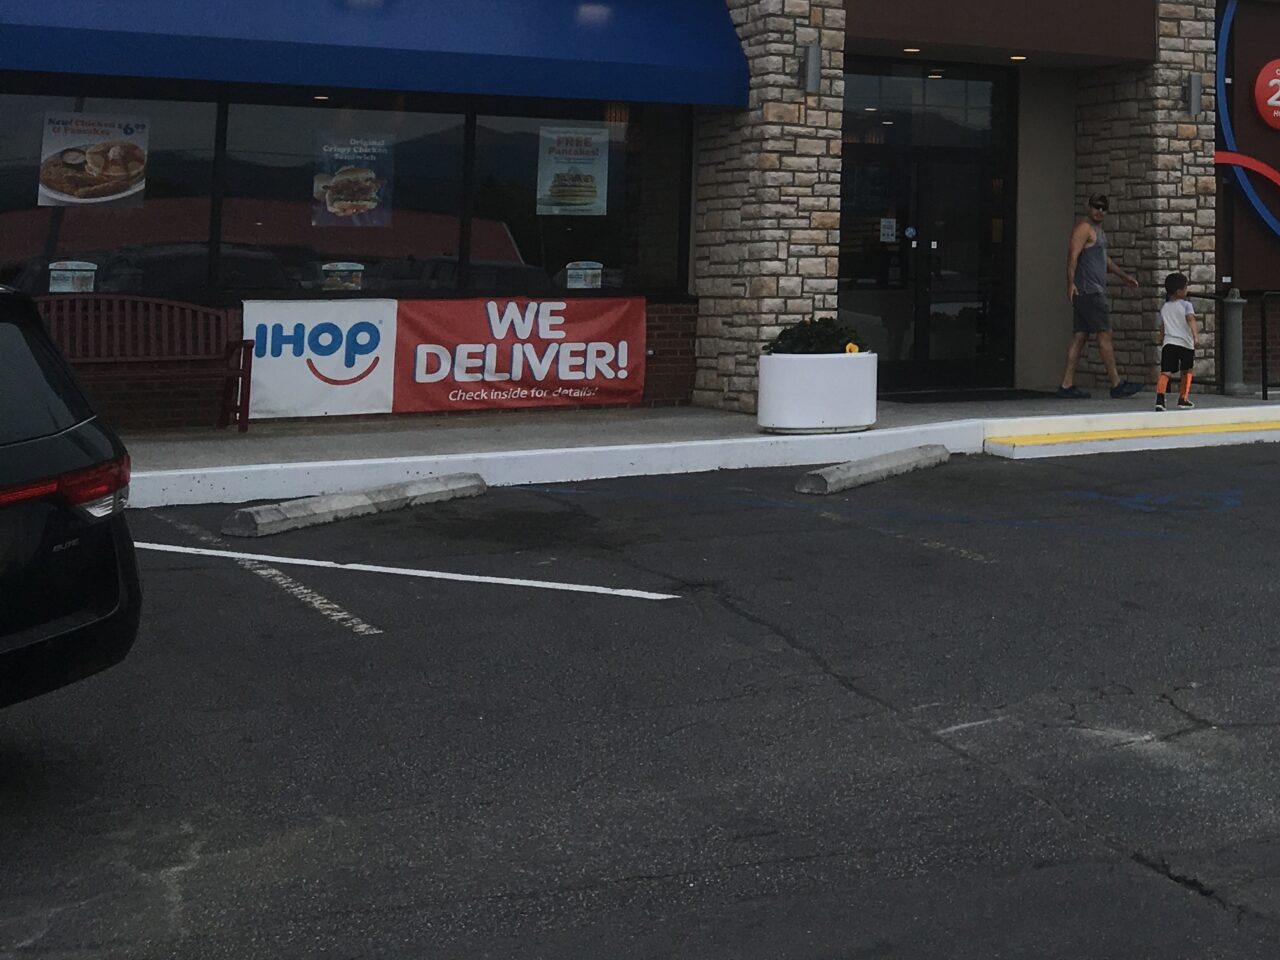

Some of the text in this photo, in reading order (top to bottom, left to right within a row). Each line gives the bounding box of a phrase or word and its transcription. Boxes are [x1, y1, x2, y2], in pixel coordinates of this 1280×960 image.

[556, 136, 593, 147] FREE
[322, 145, 388, 154] Crispy Chicken
[487, 301, 567, 340] WE
[415, 340, 628, 383] DELIVER!
[448, 387, 598, 401] Check inside for details!
